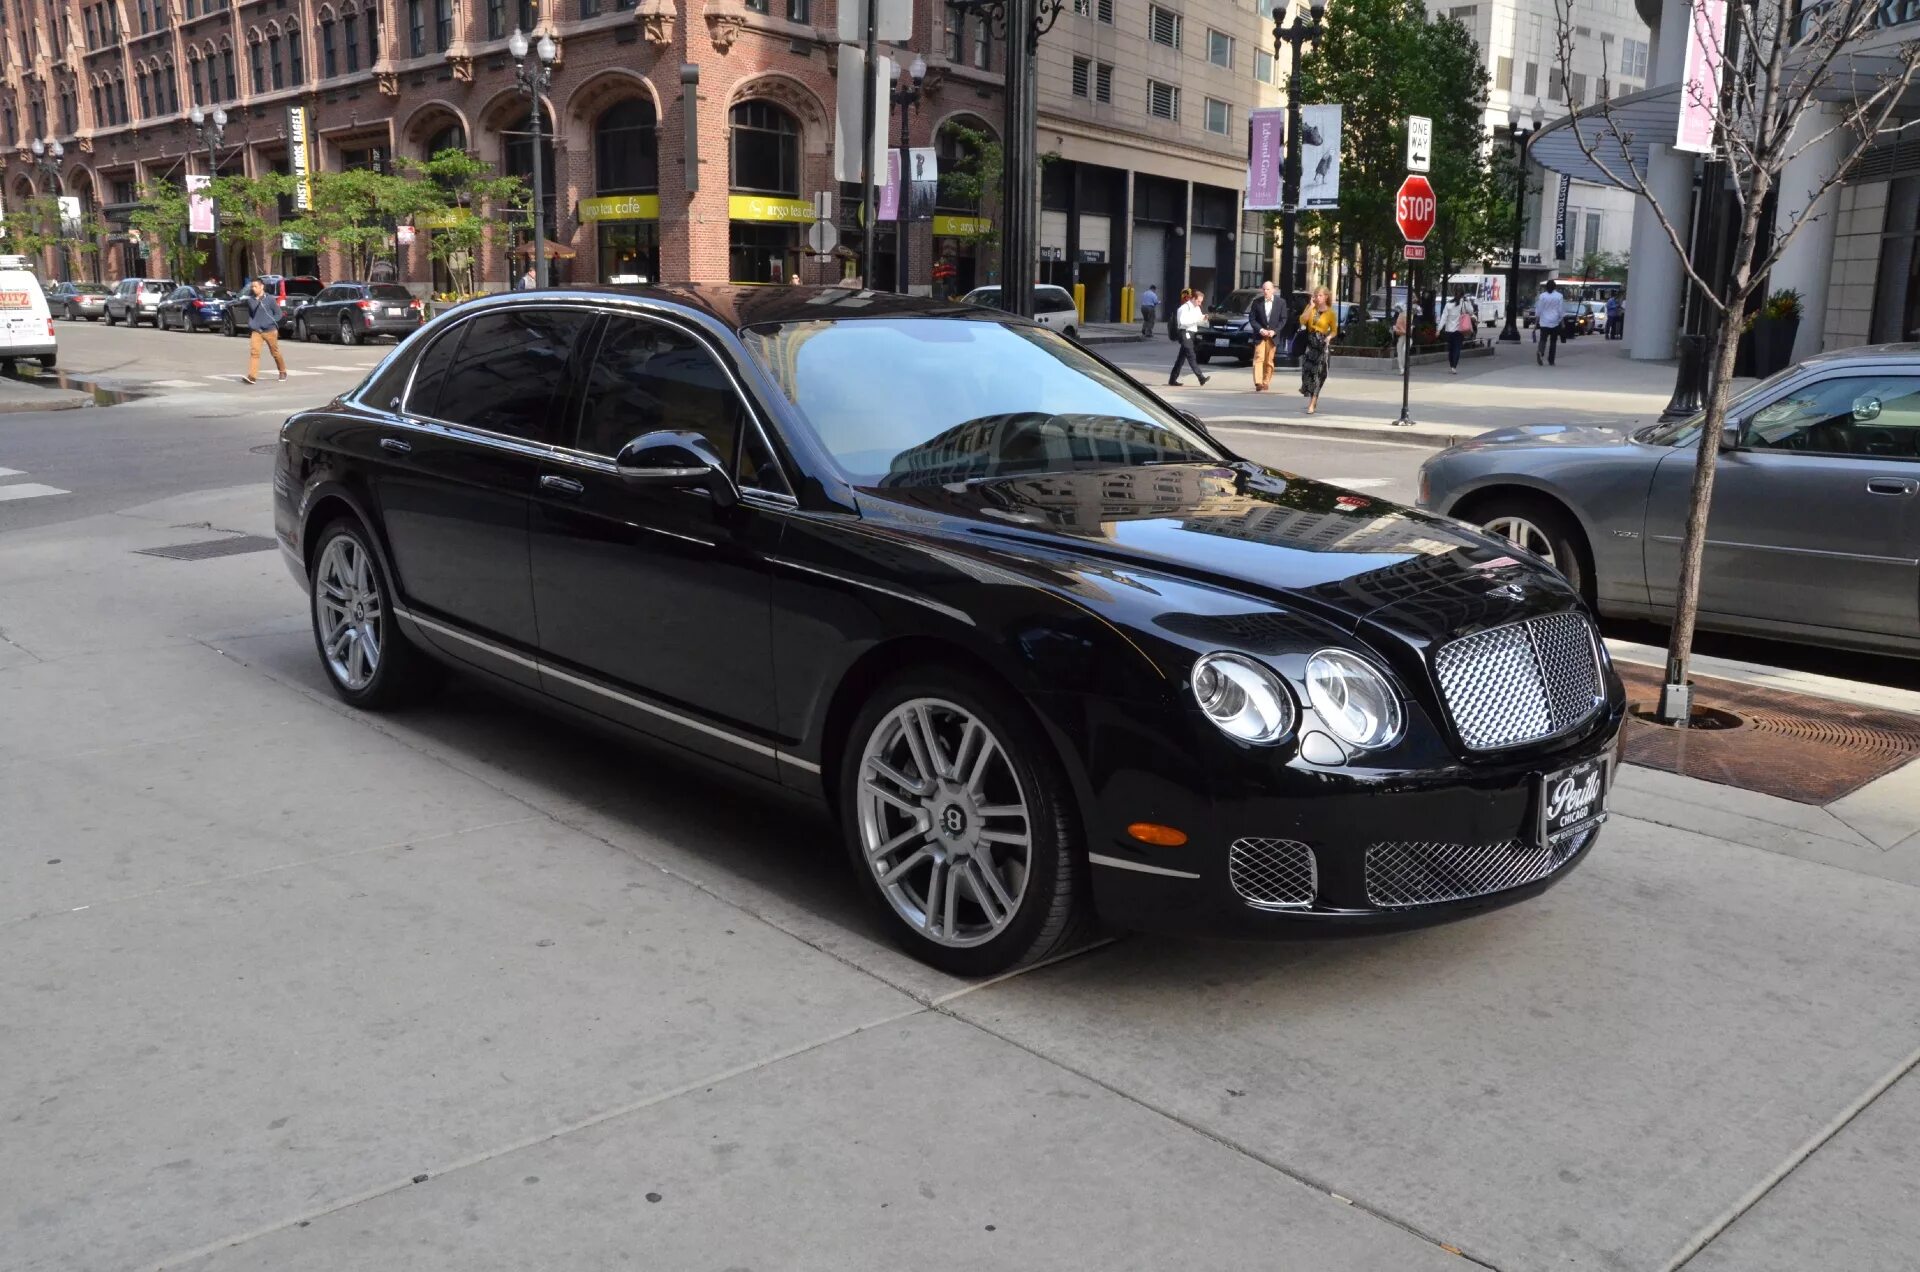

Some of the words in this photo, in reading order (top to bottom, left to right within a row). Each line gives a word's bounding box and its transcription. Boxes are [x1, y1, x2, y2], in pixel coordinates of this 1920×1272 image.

[291, 108, 303, 142] BAGELS
[1412, 122, 1428, 135] ONE
[1411, 138, 1427, 150] WAY
[296, 169, 307, 208] EINSTN
[1557, 174, 1568, 221] ORDSTROM
[601, 204, 612, 214] tea
[615, 197, 640, 214] café
[767, 205, 789, 219] argo
[790, 205, 802, 217] tea
[1399, 195, 1433, 221] STOP
[1556, 223, 1564, 246] rack
[1406, 247, 1414, 256] ALL
[1415, 248, 1423, 257] WAY
[0, 293, 29, 306] VITZ
[1547, 770, 1601, 820] Perillo
[1559, 805, 1589, 827] CHICAGO
